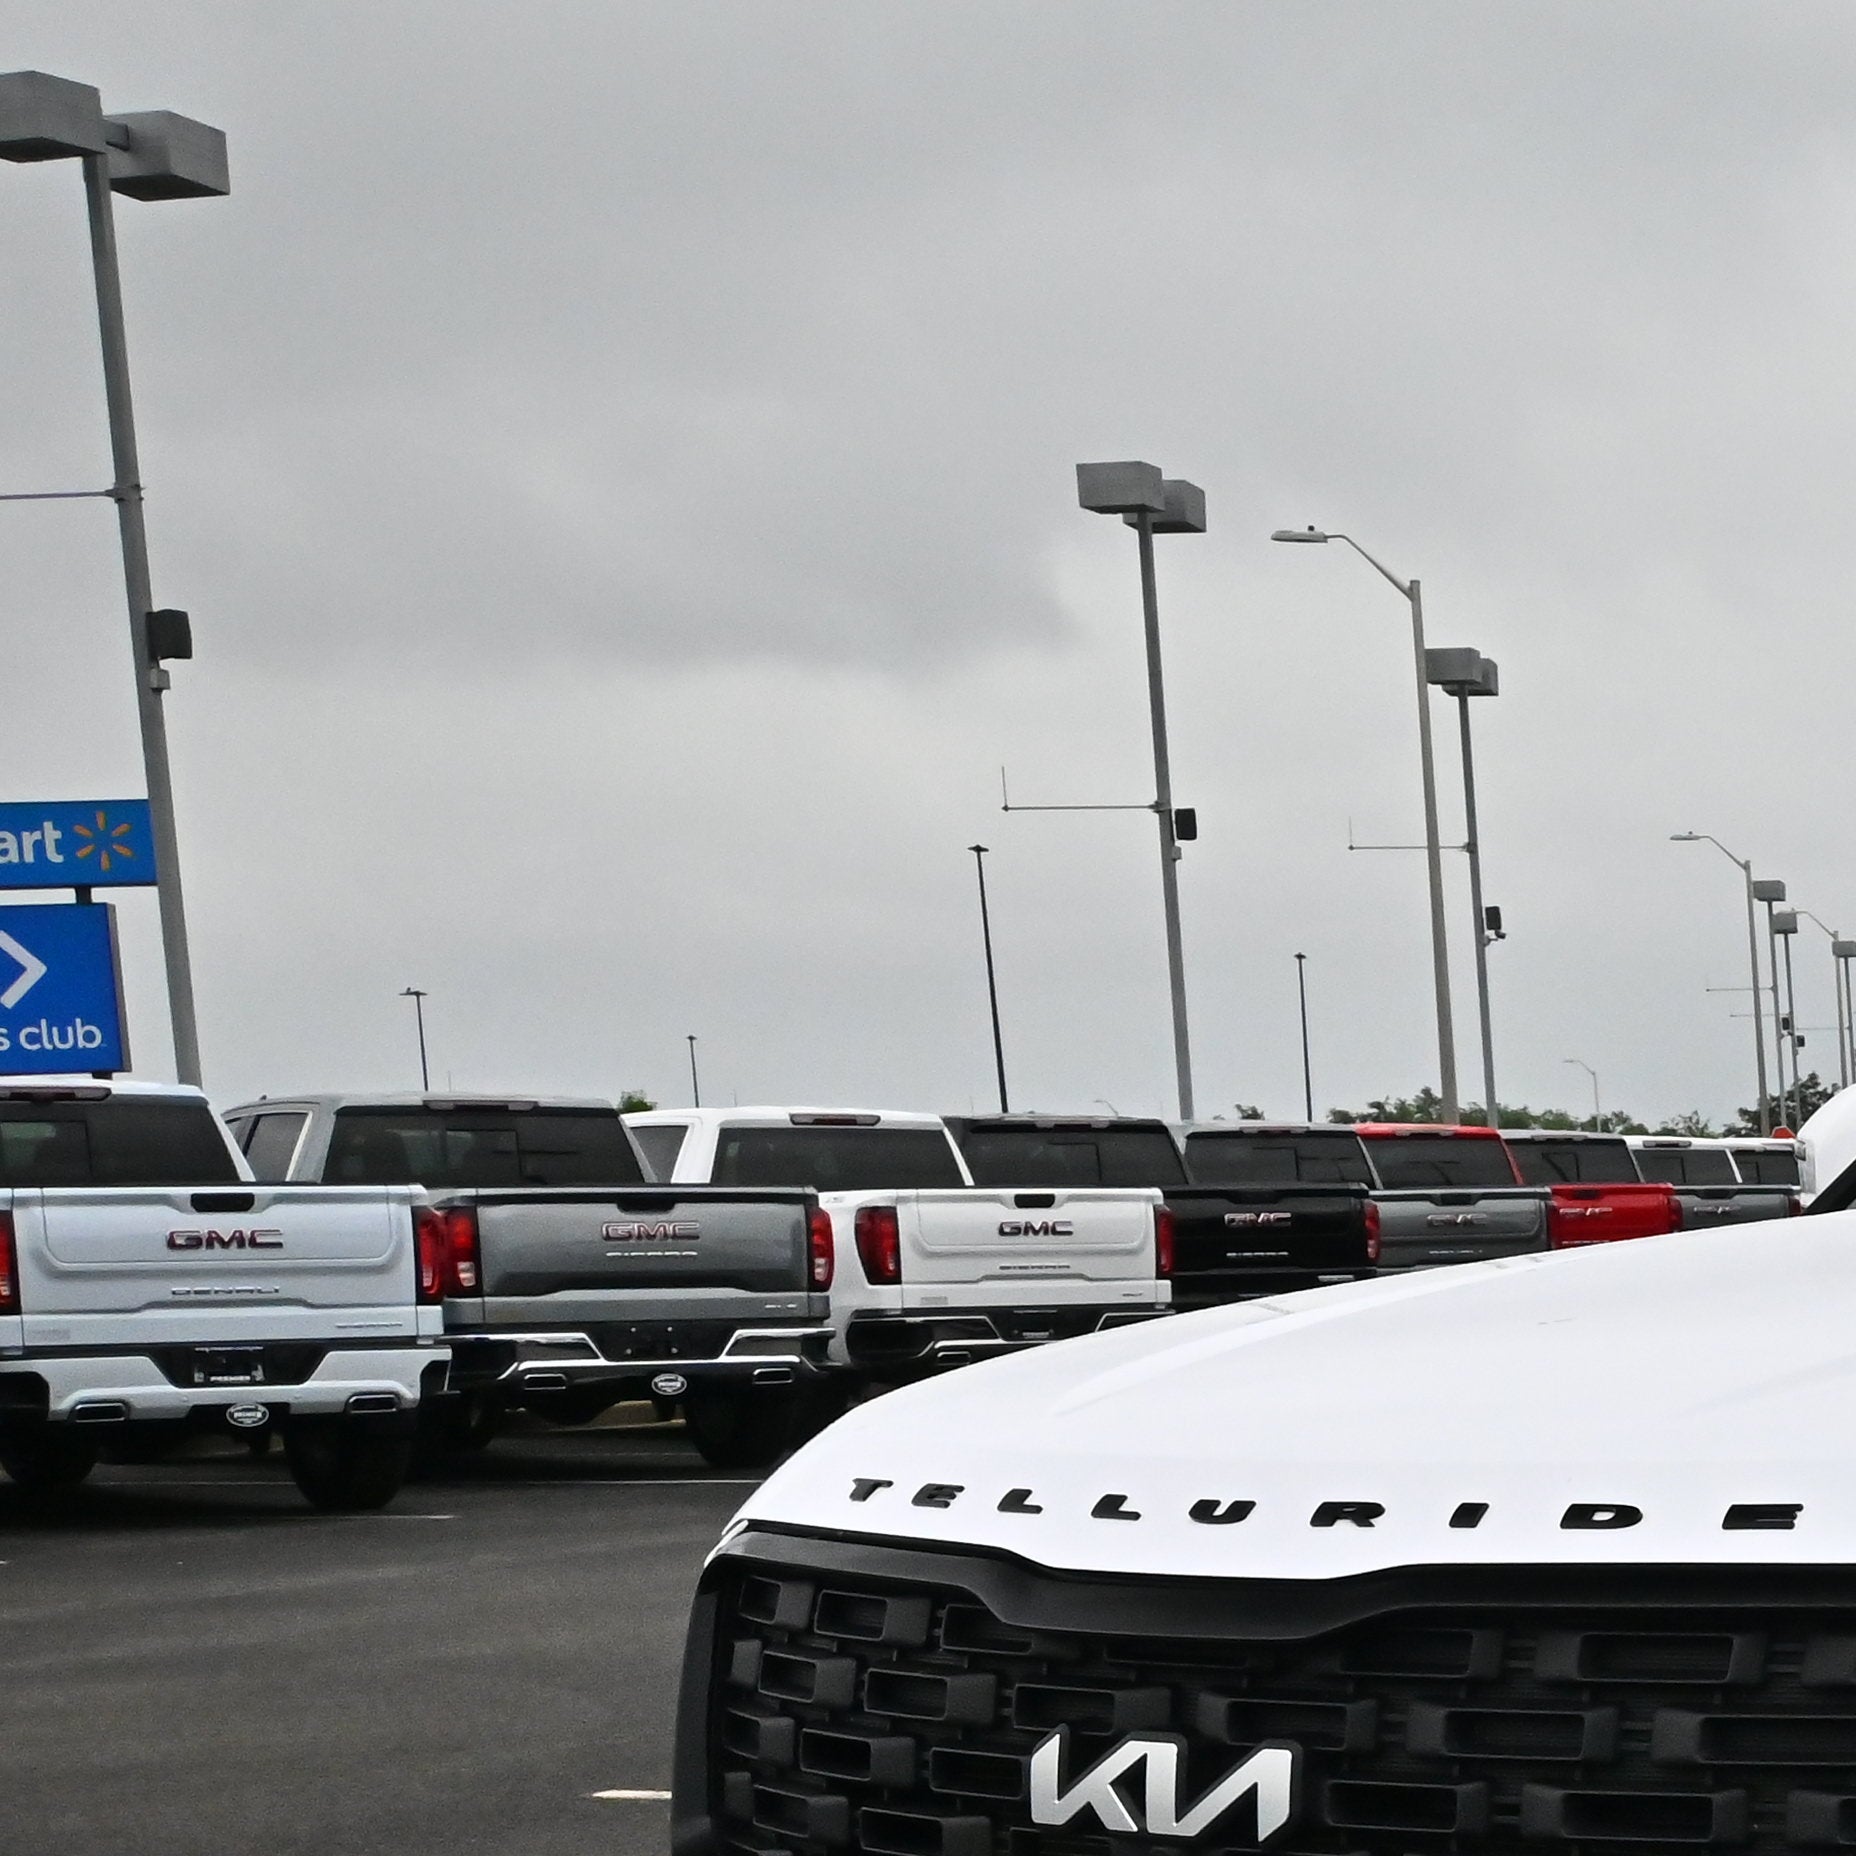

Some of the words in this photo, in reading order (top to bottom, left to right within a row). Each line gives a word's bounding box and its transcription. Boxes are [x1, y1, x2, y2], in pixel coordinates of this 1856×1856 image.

[19, 1017, 102, 1051] club
[602, 1221, 700, 1242] GMC
[998, 1220, 1074, 1237] GMC
[167, 1229, 284, 1250] GMC
[846, 1477, 1805, 1532] TELLURIDE
